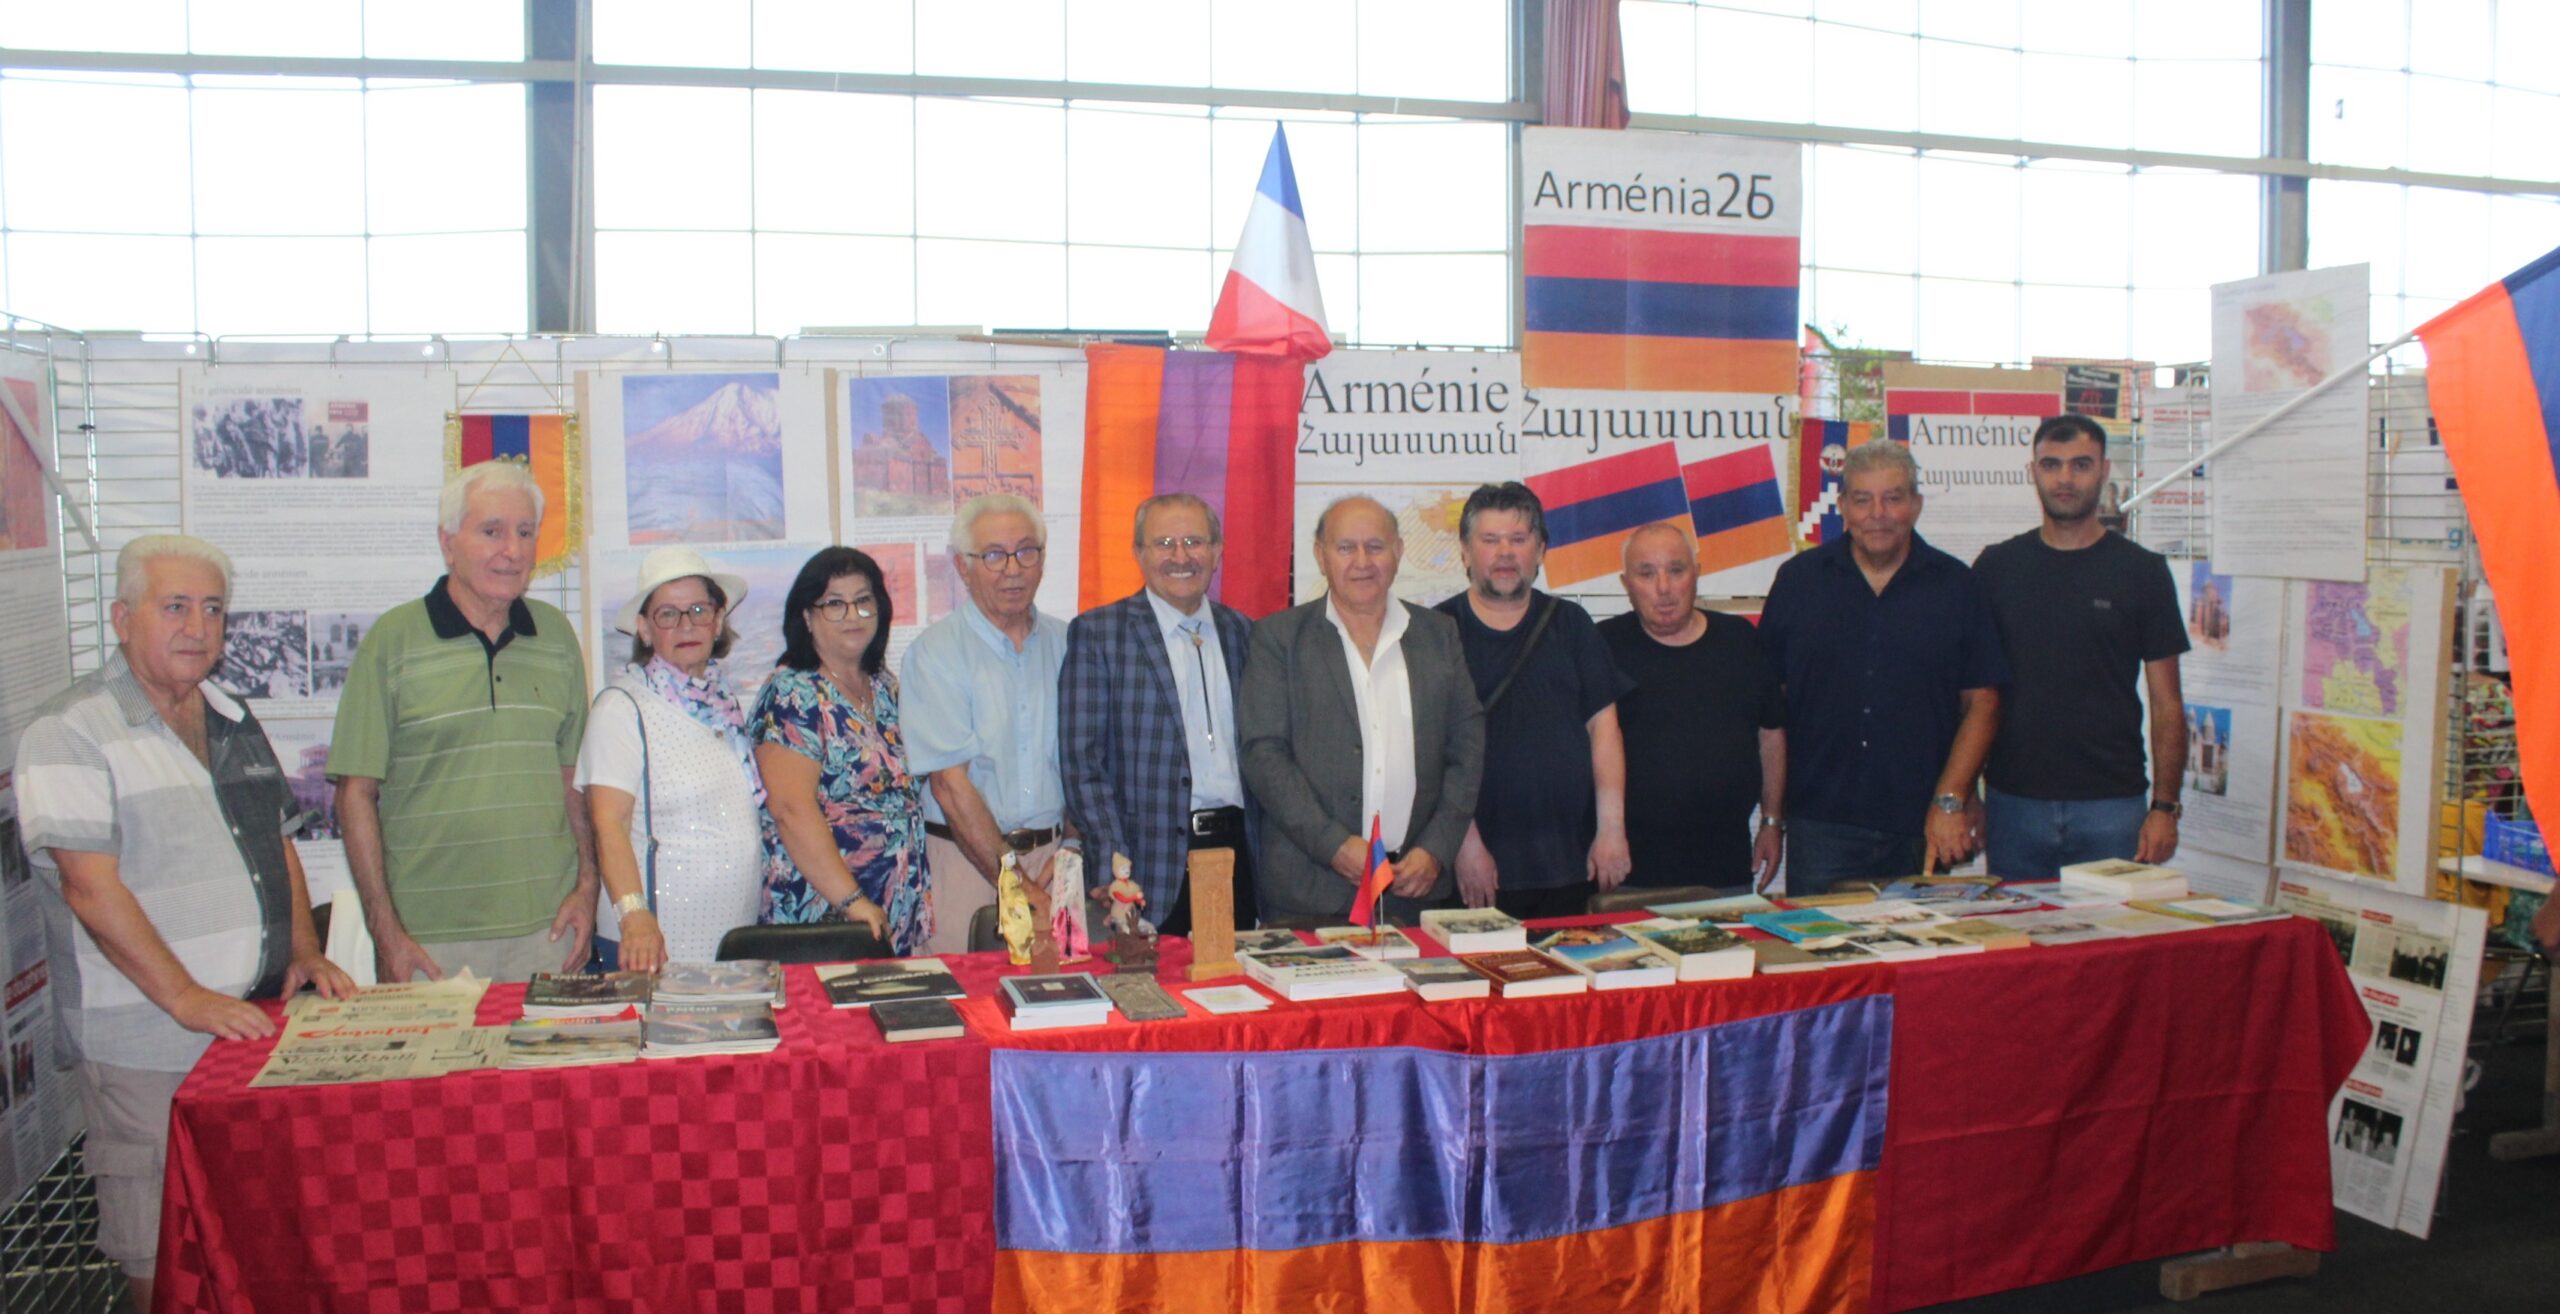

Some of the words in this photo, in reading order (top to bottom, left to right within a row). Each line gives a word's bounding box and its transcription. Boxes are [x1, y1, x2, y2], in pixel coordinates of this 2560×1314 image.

[1298, 366, 1510, 413] Arménie
[1298, 419, 1519, 466] Հայաստան
[1911, 416, 2032, 447] Arménie
